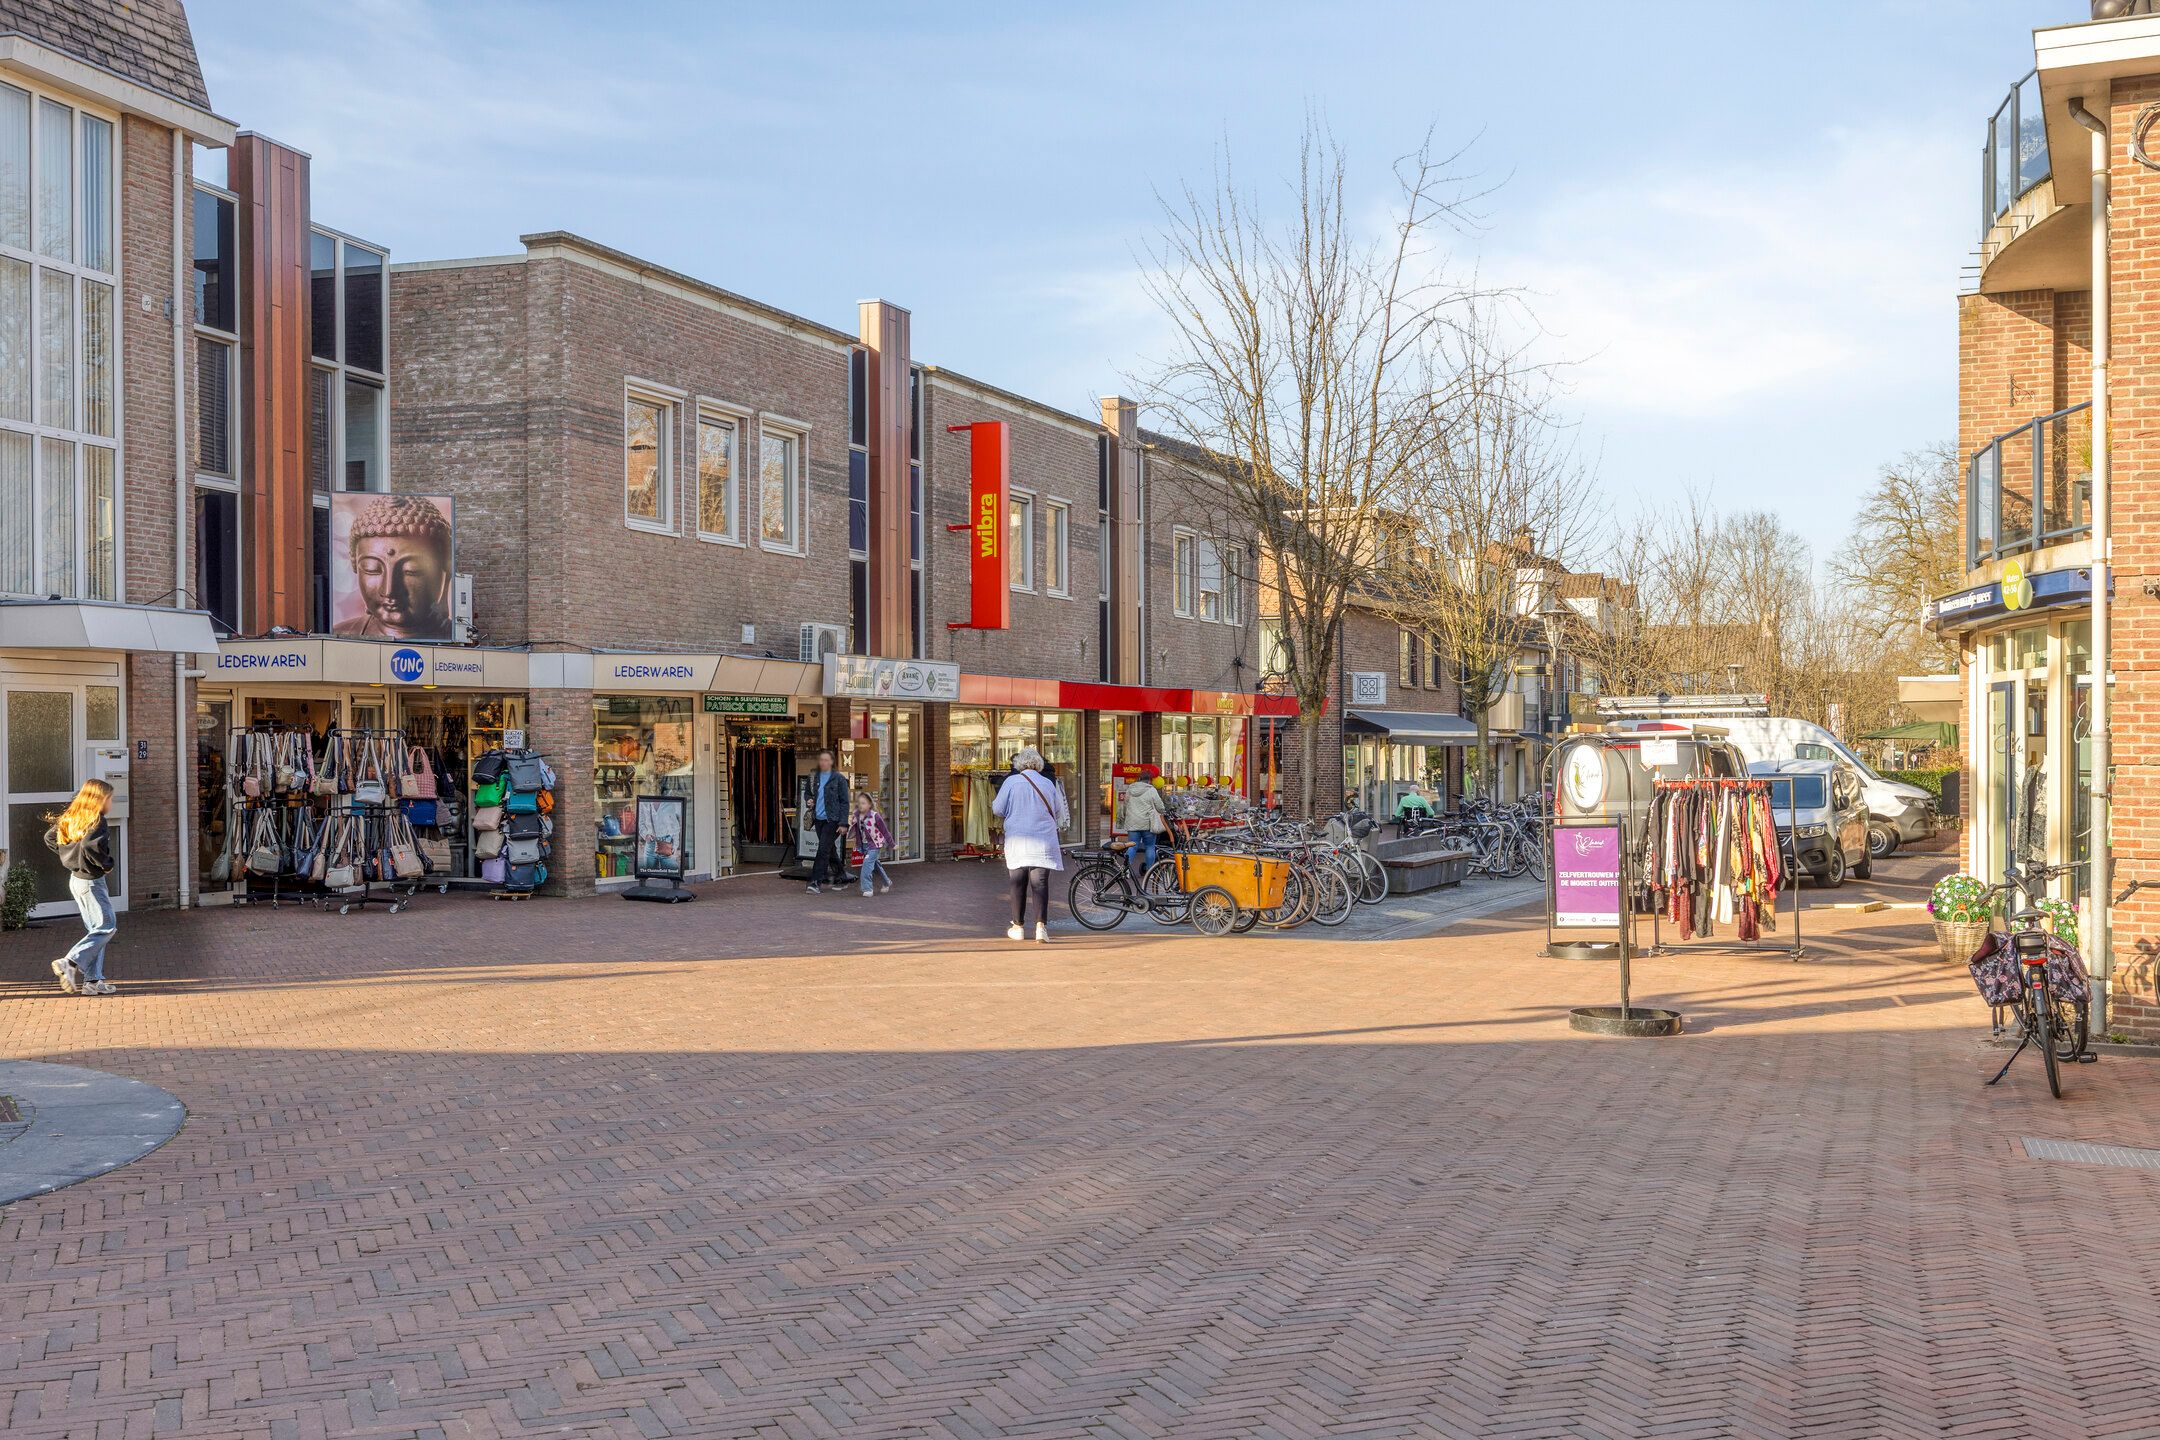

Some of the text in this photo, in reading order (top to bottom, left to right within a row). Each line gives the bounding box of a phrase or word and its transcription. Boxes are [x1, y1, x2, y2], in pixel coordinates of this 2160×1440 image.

[977, 493, 994, 558] wibra
[217, 654, 306, 668] LEDERWAREN
[392, 656, 423, 673] TUNC
[435, 662, 482, 673] LEDERWAREN
[614, 665, 693, 678] LEDERWAREN
[706, 702, 745, 712] PATRICK
[140, 741, 147, 749] 31
[138, 750, 147, 759] 29
[1123, 765, 1142, 773] wibra
[1559, 871, 1614, 879] ZELFVERTROUWEN
